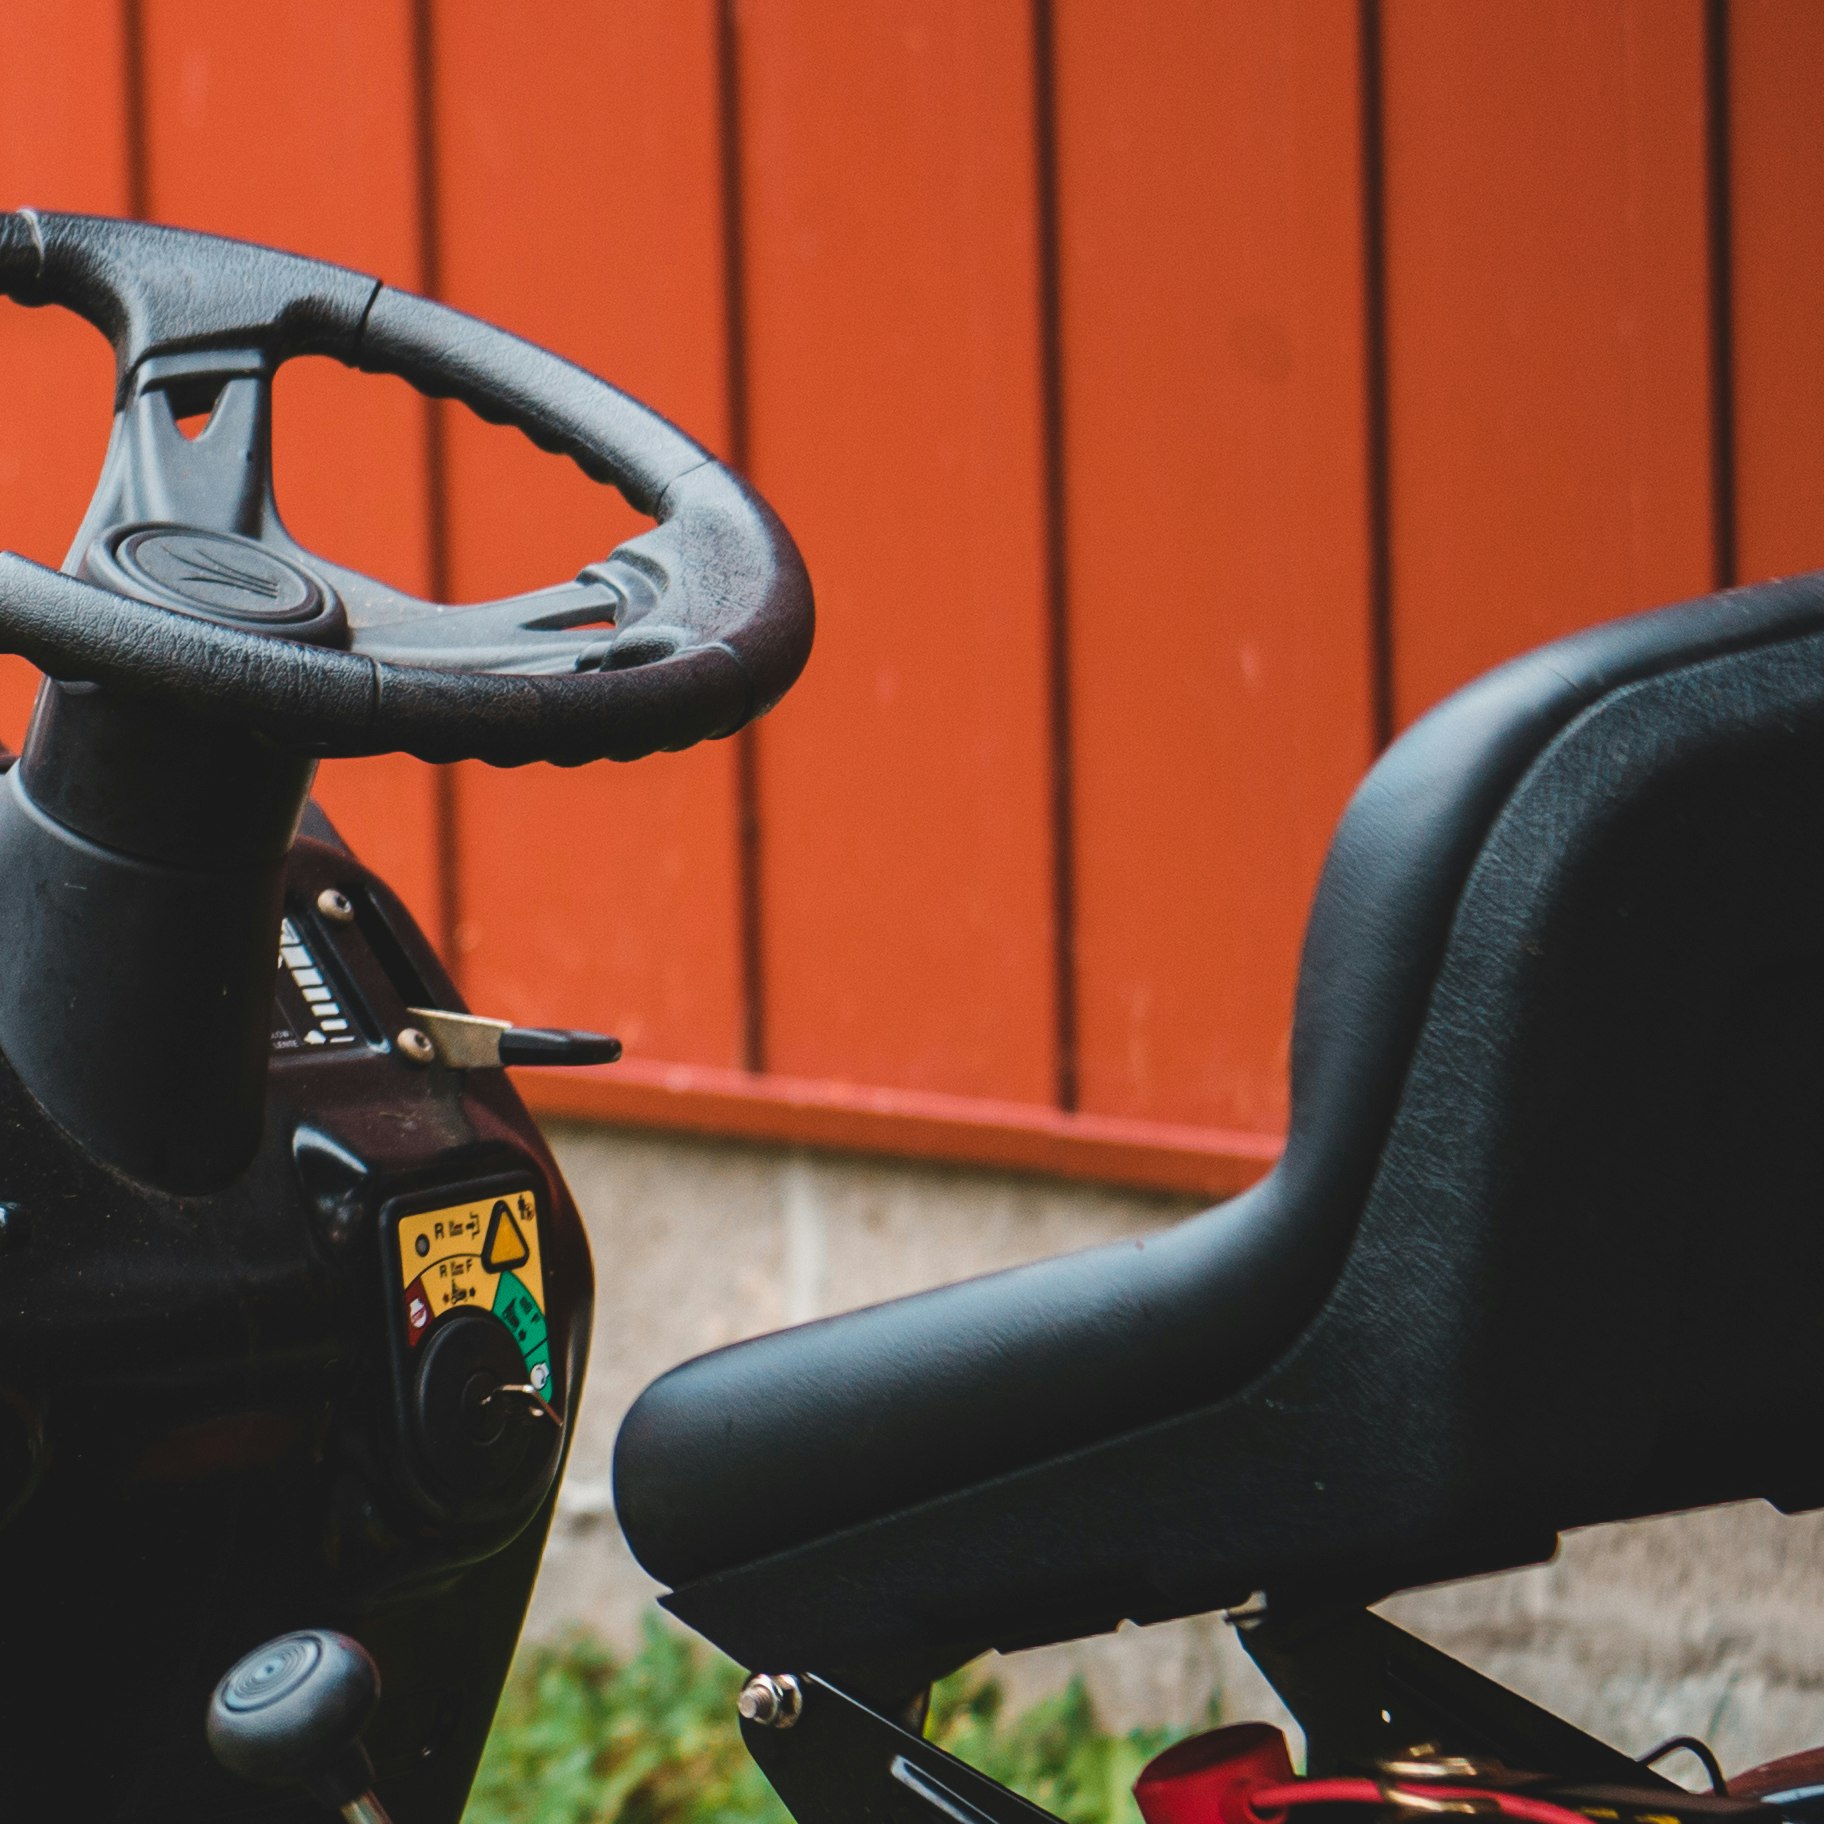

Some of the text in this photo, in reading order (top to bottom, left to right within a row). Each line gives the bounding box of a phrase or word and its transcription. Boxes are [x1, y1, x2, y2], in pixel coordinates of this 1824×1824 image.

[434, 1222, 444, 1240] R
[439, 1259, 473, 1277] R F
